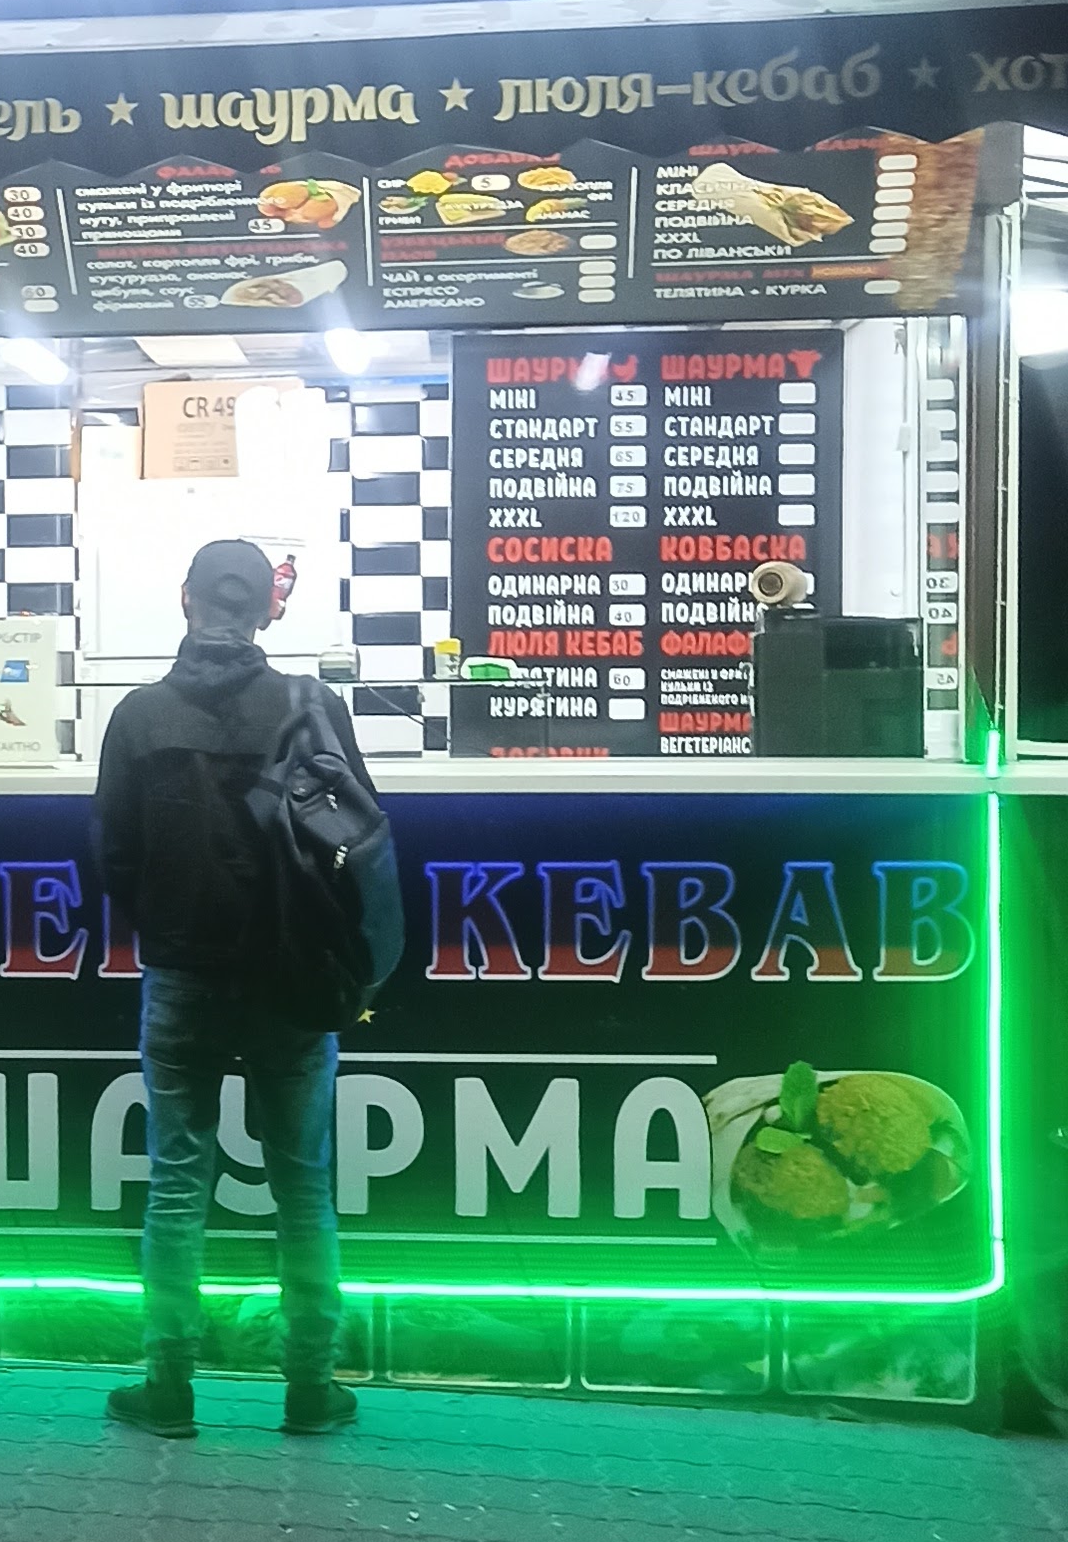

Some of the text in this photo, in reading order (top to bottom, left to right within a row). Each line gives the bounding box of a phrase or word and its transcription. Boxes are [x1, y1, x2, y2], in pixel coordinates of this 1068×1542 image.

[160, 83, 420, 146] шаурма
[494, 44, 882, 122] люля-кебаб
[656, 165, 699, 179] МІНІ
[9, 190, 30, 200] 30
[654, 199, 735, 212] СЕРЕДНЯ
[11, 208, 33, 219] 40
[655, 213, 754, 228] ПОДВІЙНА
[17, 244, 38, 254] 40
[653, 245, 792, 260] ПО ЛІВАНСЬКИ
[653, 286, 744, 299] ТЕЛЯТИНА
[765, 283, 827, 297] КУРКА
[661, 352, 785, 380] ШАУРМА
[183, 397, 208, 418] CR
[489, 388, 536, 409] МІНІ
[664, 385, 712, 407] МІНІ
[489, 417, 598, 440] СТАНДАРТ
[664, 415, 774, 439] СТАНДАРТ
[489, 447, 583, 470] СЕРЕДНЯ
[664, 445, 759, 469] СЕРЕДНЯ
[489, 472, 597, 500] ПОДВІЙНА
[664, 470, 772, 498] ПОДВІЙНА
[488, 507, 543, 528] XXXL
[663, 506, 717, 527] XXXL
[487, 536, 613, 563] СОСИСКА
[660, 535, 806, 562] КОВБАСКА
[488, 575, 601, 598] ОДИНАРНА
[661, 572, 752, 596] ОДИНАР
[488, 599, 595, 627] ПОДВІЙНА
[488, 631, 644, 656] ЛЮЛЯ КЕБАБ
[661, 630, 753, 656] ФАЛАФ
[490, 696, 598, 717] КУРЯТИНА
[660, 736, 752, 754] ВЕГЕТЕРІАНС
[425, 858, 976, 984] KEBAB
